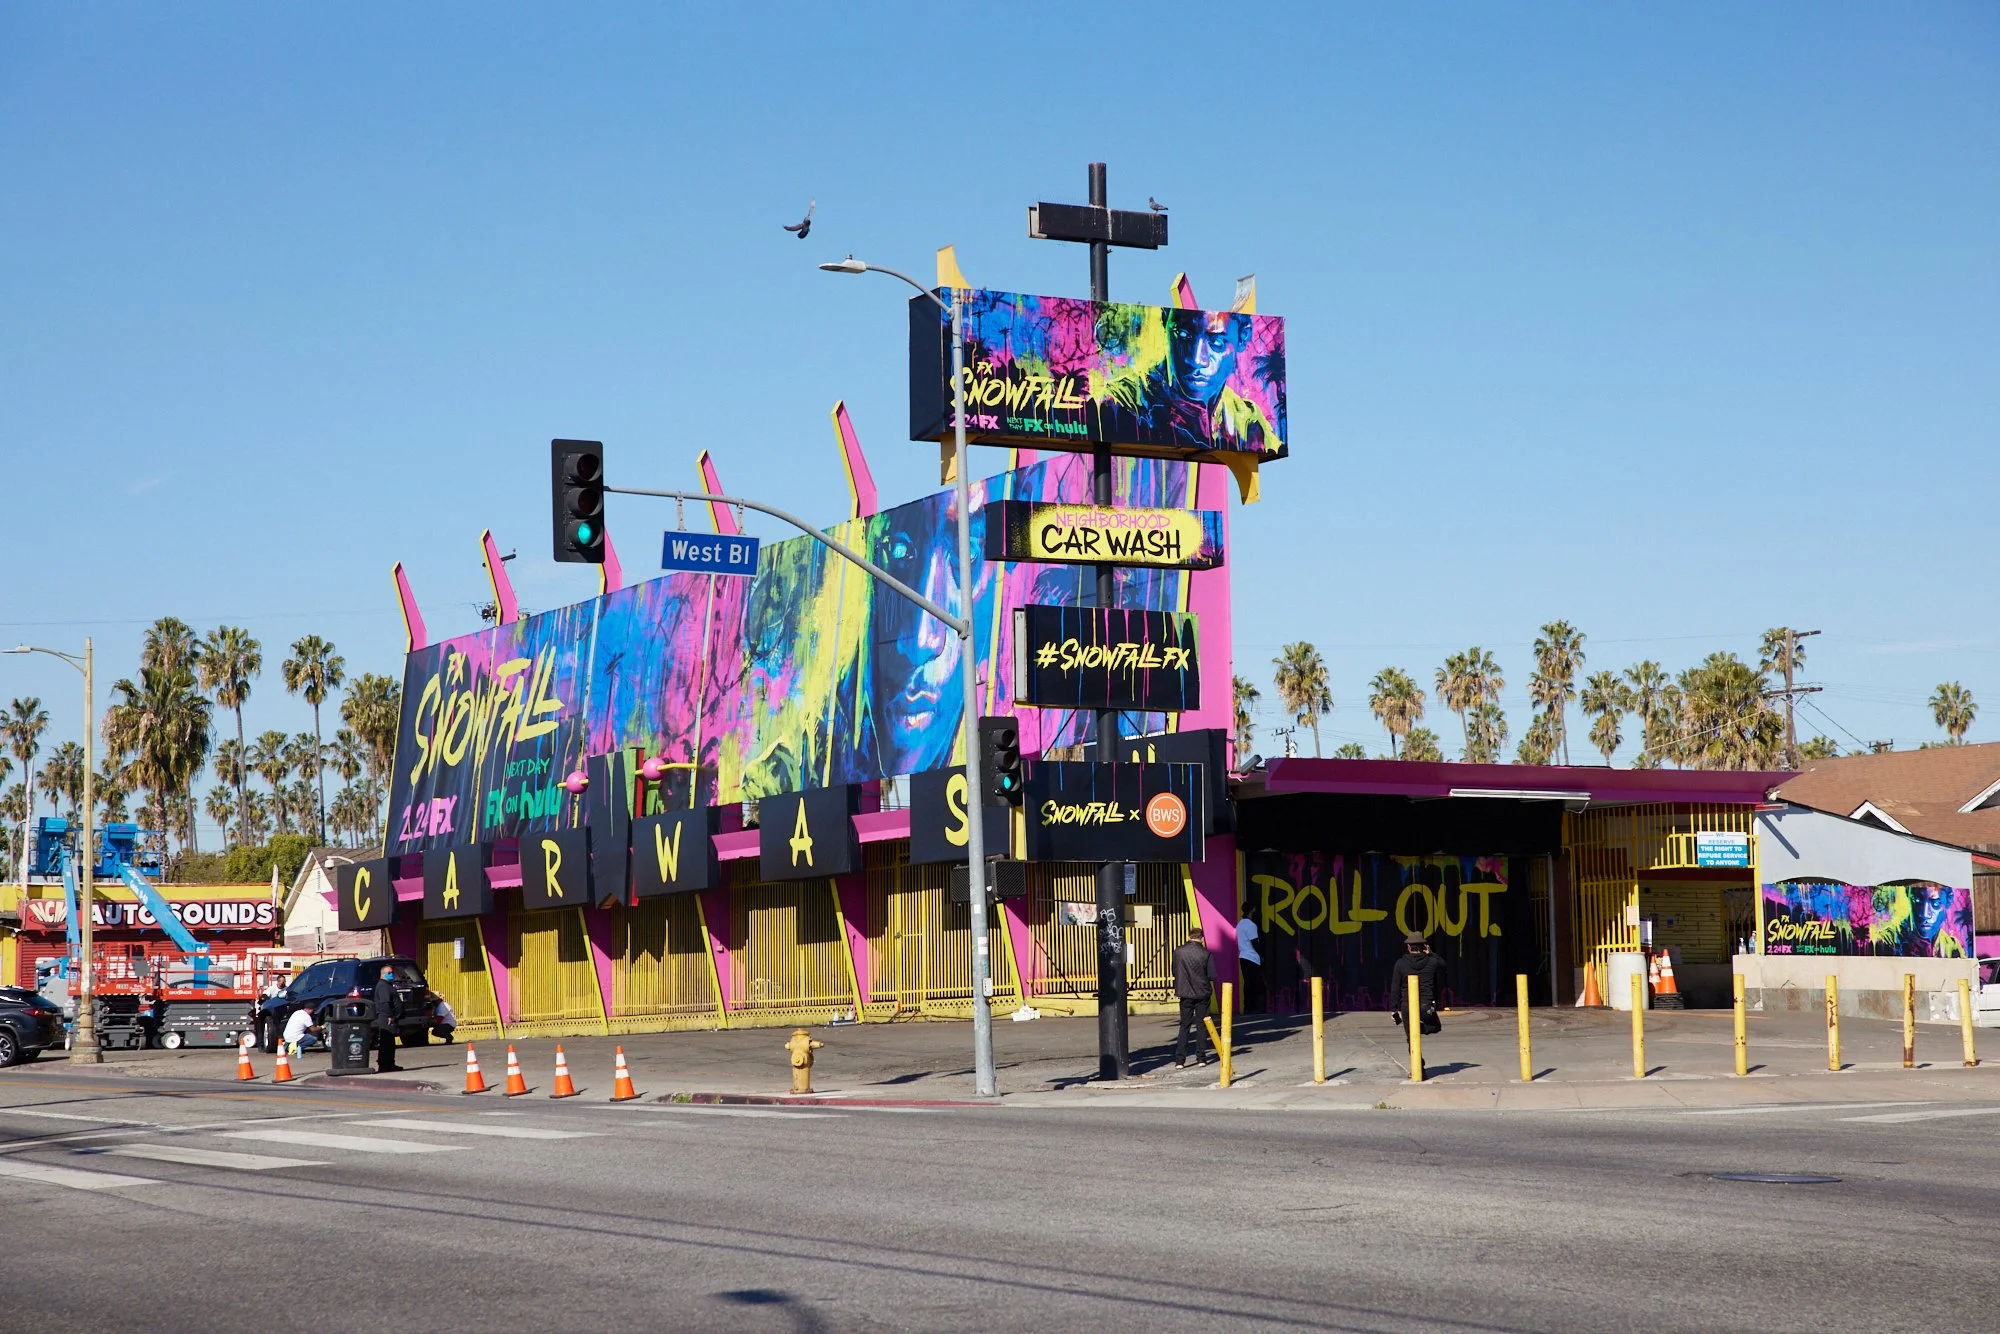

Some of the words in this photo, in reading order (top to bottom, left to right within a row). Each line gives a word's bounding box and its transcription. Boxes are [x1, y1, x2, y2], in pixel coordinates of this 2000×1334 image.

[977, 362, 993, 375] FX
[1024, 418, 1044, 432] FX
[1054, 419, 1088, 435] hulu
[1056, 511, 1171, 529] NEIGHBORHOOD
[672, 540, 722, 563] West
[729, 544, 750, 565] Bl
[1042, 524, 1101, 555] CAR
[1105, 529, 1181, 559] WASH
[446, 651, 467, 686] FX
[410, 642, 565, 786] SNOWFALL
[506, 760, 525, 778] NEXT
[527, 757, 550, 776] DAY
[485, 786, 508, 829] FX
[505, 794, 518, 813] ON
[519, 777, 563, 820] hulu
[1041, 800, 1125, 826] SNOWFALL
[1152, 808, 1180, 823] BWS
[91, 902, 157, 925] AUTO
[169, 902, 274, 925] SOUNDS
[1252, 870, 1388, 936] ROLL
[1767, 919, 1836, 942] SNOWFALL
[1820, 944, 1837, 953] hulu
